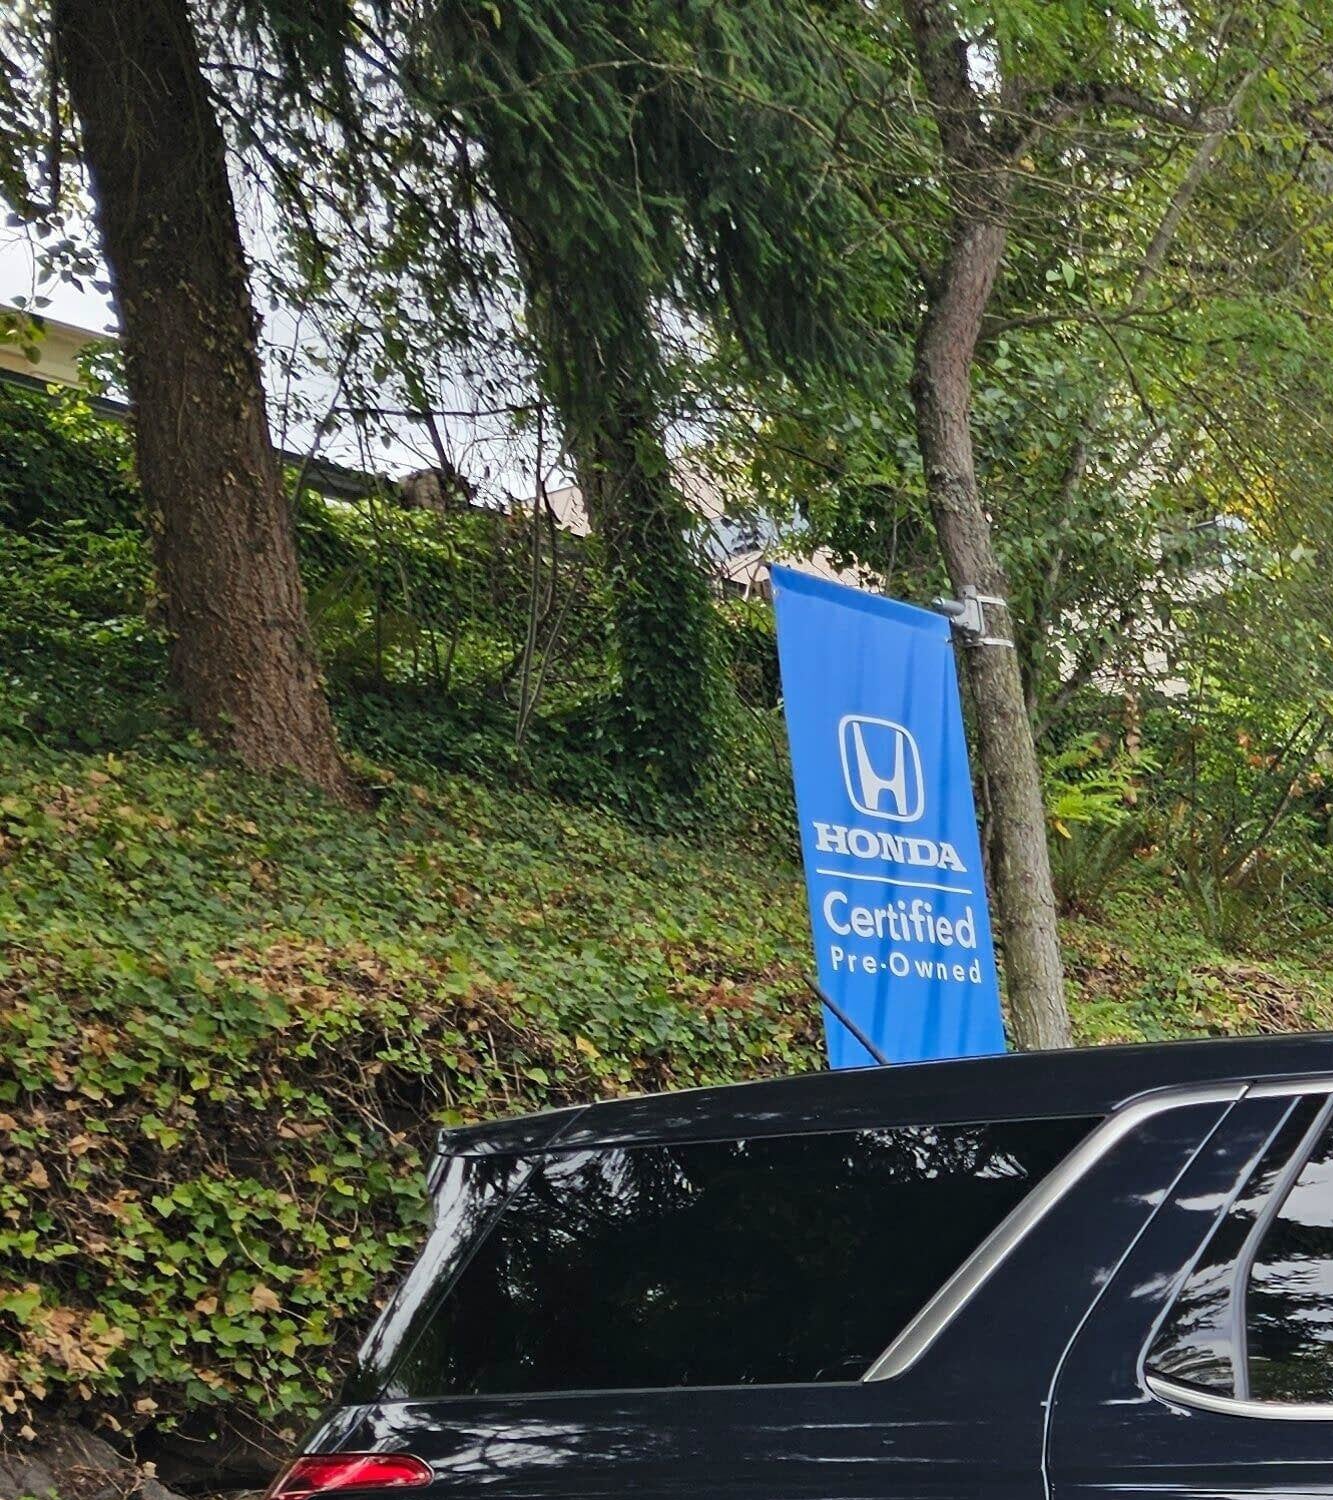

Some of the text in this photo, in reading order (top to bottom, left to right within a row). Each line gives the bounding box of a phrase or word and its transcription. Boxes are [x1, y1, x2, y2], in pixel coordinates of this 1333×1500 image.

[812, 821, 968, 873] HONDA
[823, 890, 977, 949] Certified
[830, 944, 982, 984] Pre-Owned
